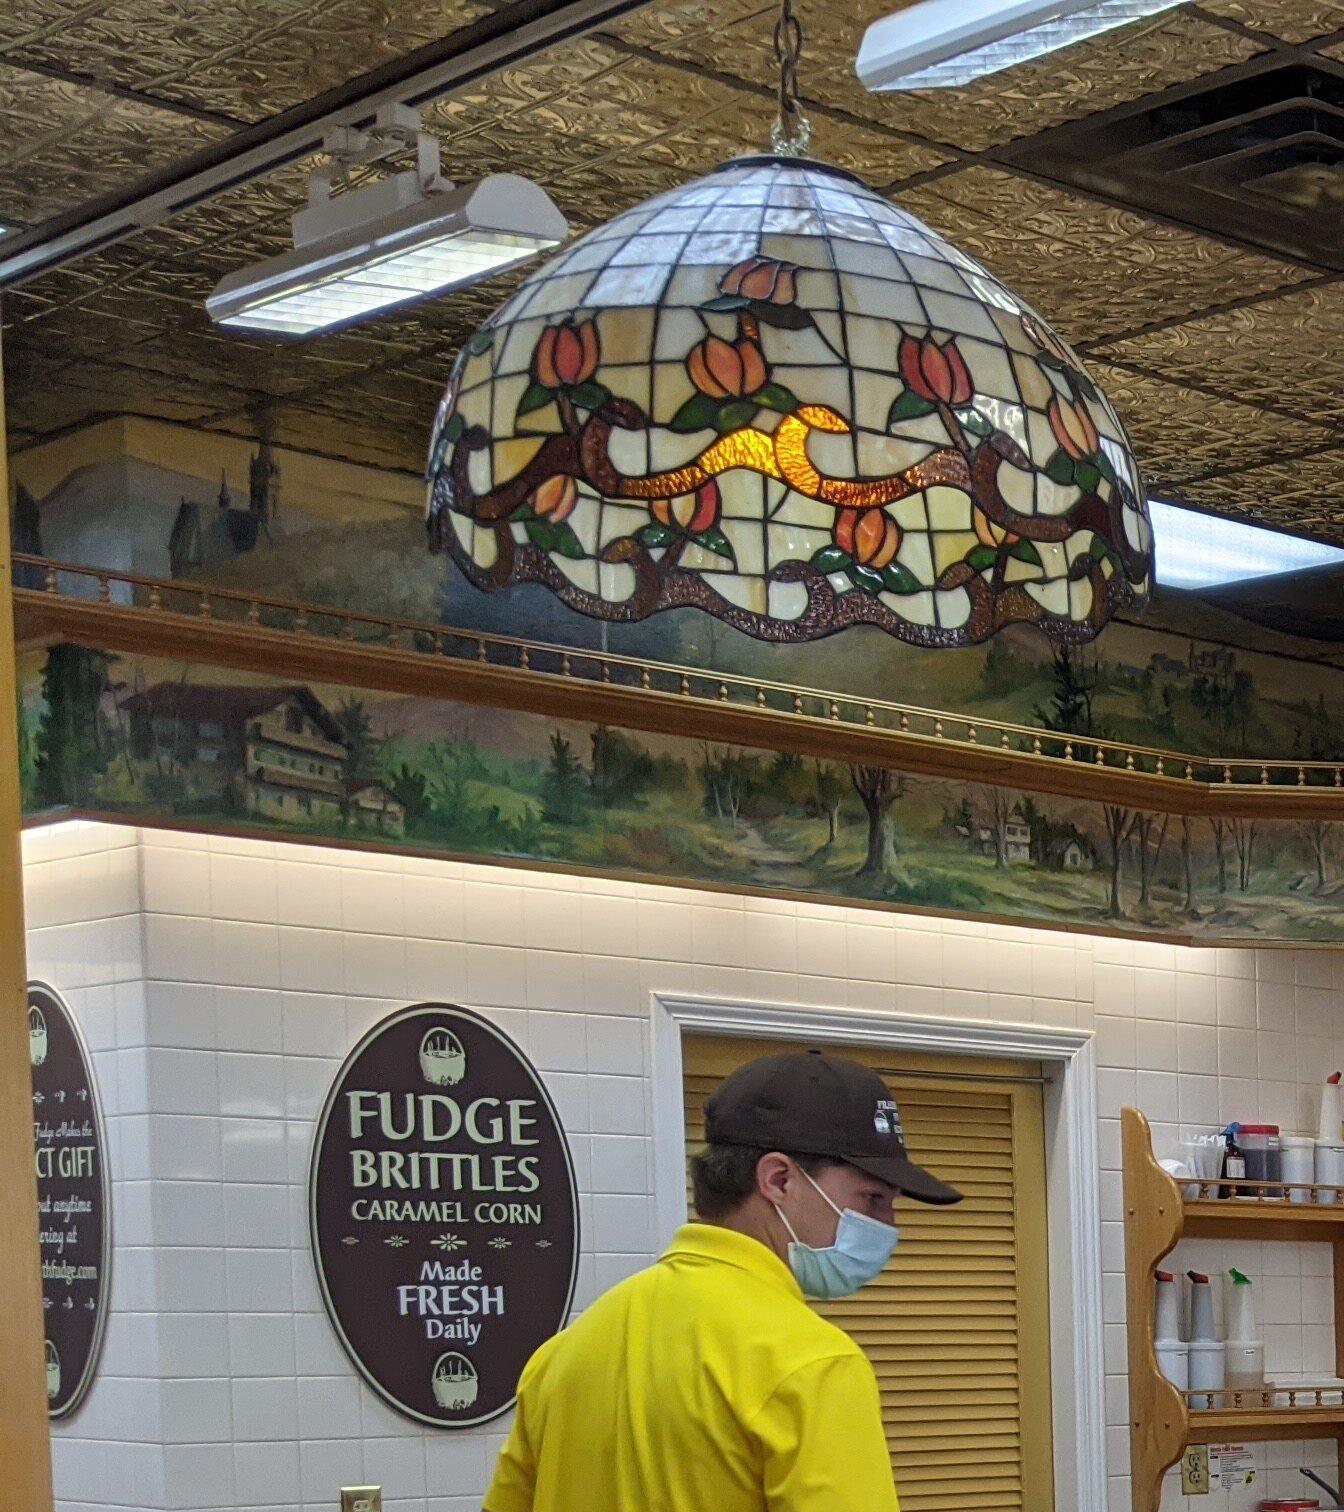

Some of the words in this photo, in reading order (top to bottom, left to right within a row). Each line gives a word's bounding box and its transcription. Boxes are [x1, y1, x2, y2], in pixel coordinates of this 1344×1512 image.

[346, 1090, 540, 1146] FUDGE
[58, 1146, 96, 1178] GIFT
[349, 1150, 540, 1193] BRITTLES
[53, 1195, 93, 1223] anytime
[351, 1199, 469, 1223] CARAMEL
[474, 1202, 542, 1225] CORN
[66, 1225, 78, 1243] at
[420, 1259, 482, 1281] Made
[396, 1285, 505, 1316] FRESH
[425, 1317, 482, 1346] Daily
